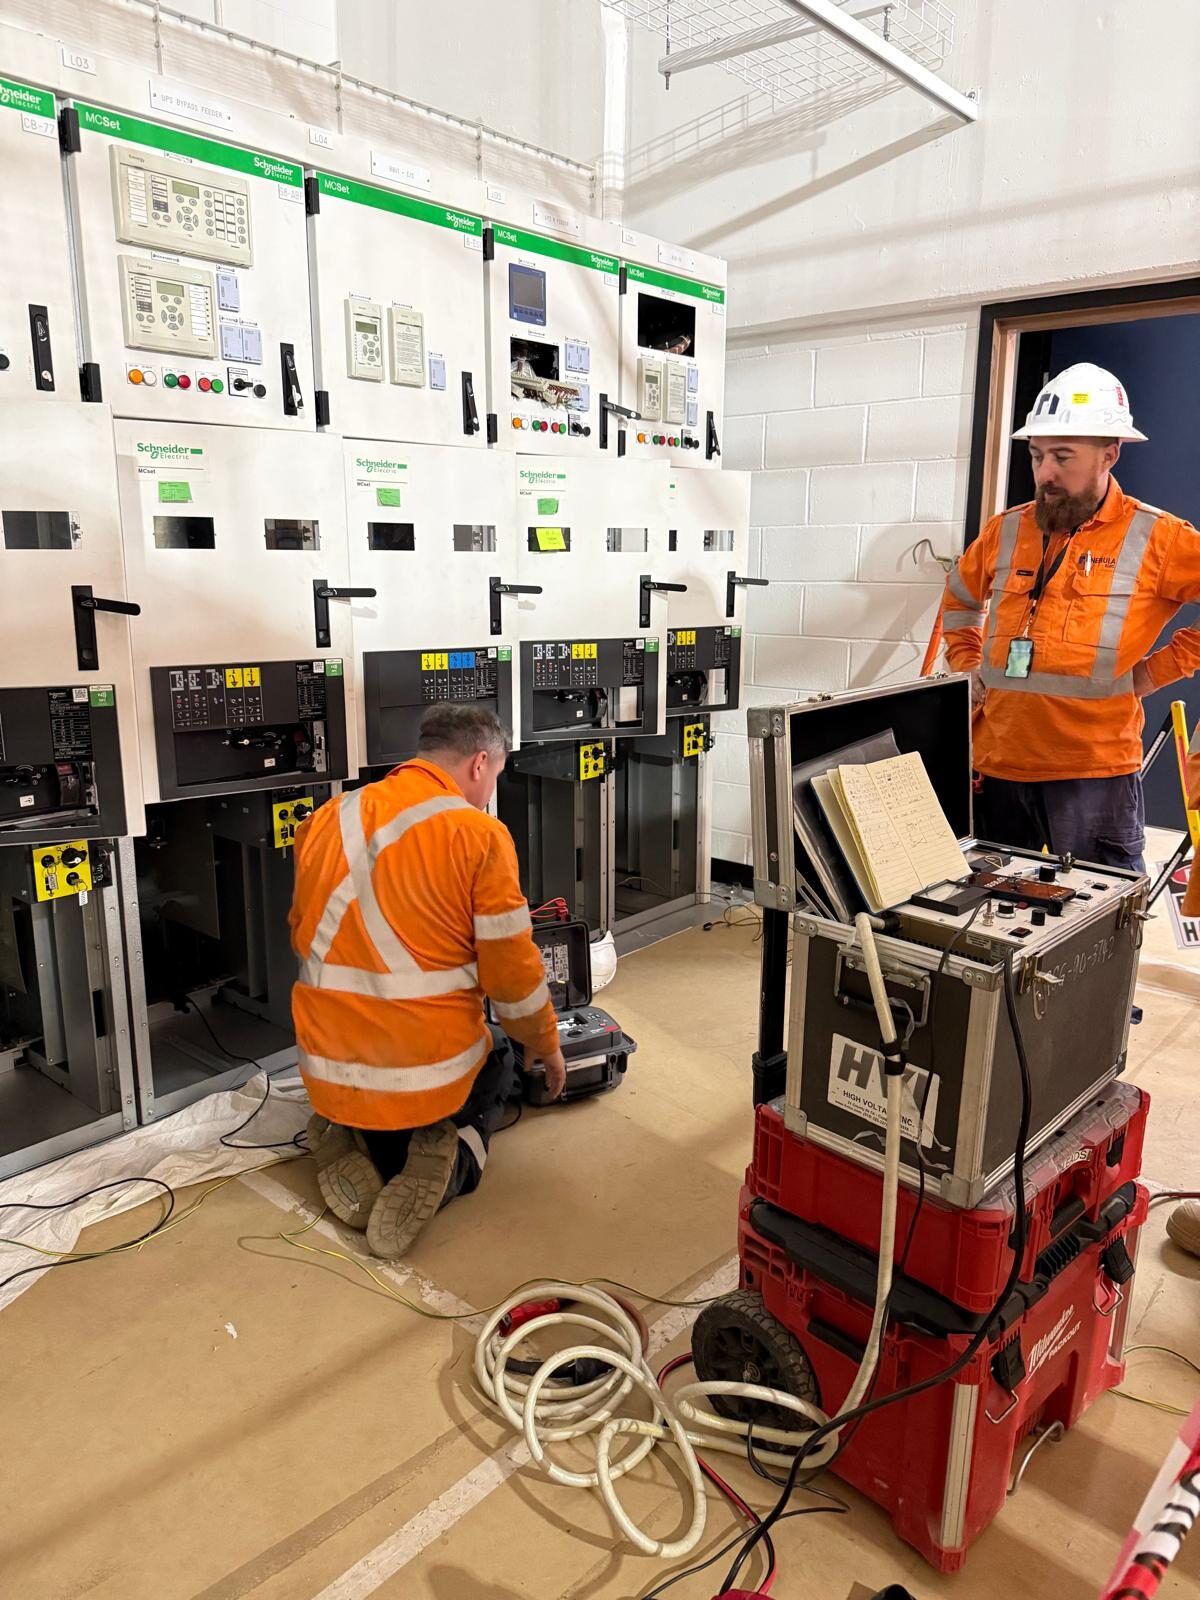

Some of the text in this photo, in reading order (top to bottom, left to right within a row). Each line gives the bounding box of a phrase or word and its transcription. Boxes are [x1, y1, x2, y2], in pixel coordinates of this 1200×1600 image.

[0, 82, 42, 104] hneider
[161, 94, 223, 118] UPS BYPASS FEEDER
[85, 112, 121, 131] MCSet
[253, 156, 294, 176] Schneider
[324, 179, 350, 194] MCSet
[445, 212, 476, 228] Schneider
[497, 229, 518, 243] MCSet
[590, 254, 614, 268] Schneider
[137, 442, 190, 460] Schneider
[160, 452, 189, 460] Electric
[356, 458, 398, 473] Schneider
[519, 470, 557, 484] Schneider
[843, 1090, 861, 1104] HIGH
[901, 1116, 915, 1128] NC.
[1026, 1304, 1075, 1376] Milwaukee
[1048, 1320, 1082, 1361] PACKOUT
